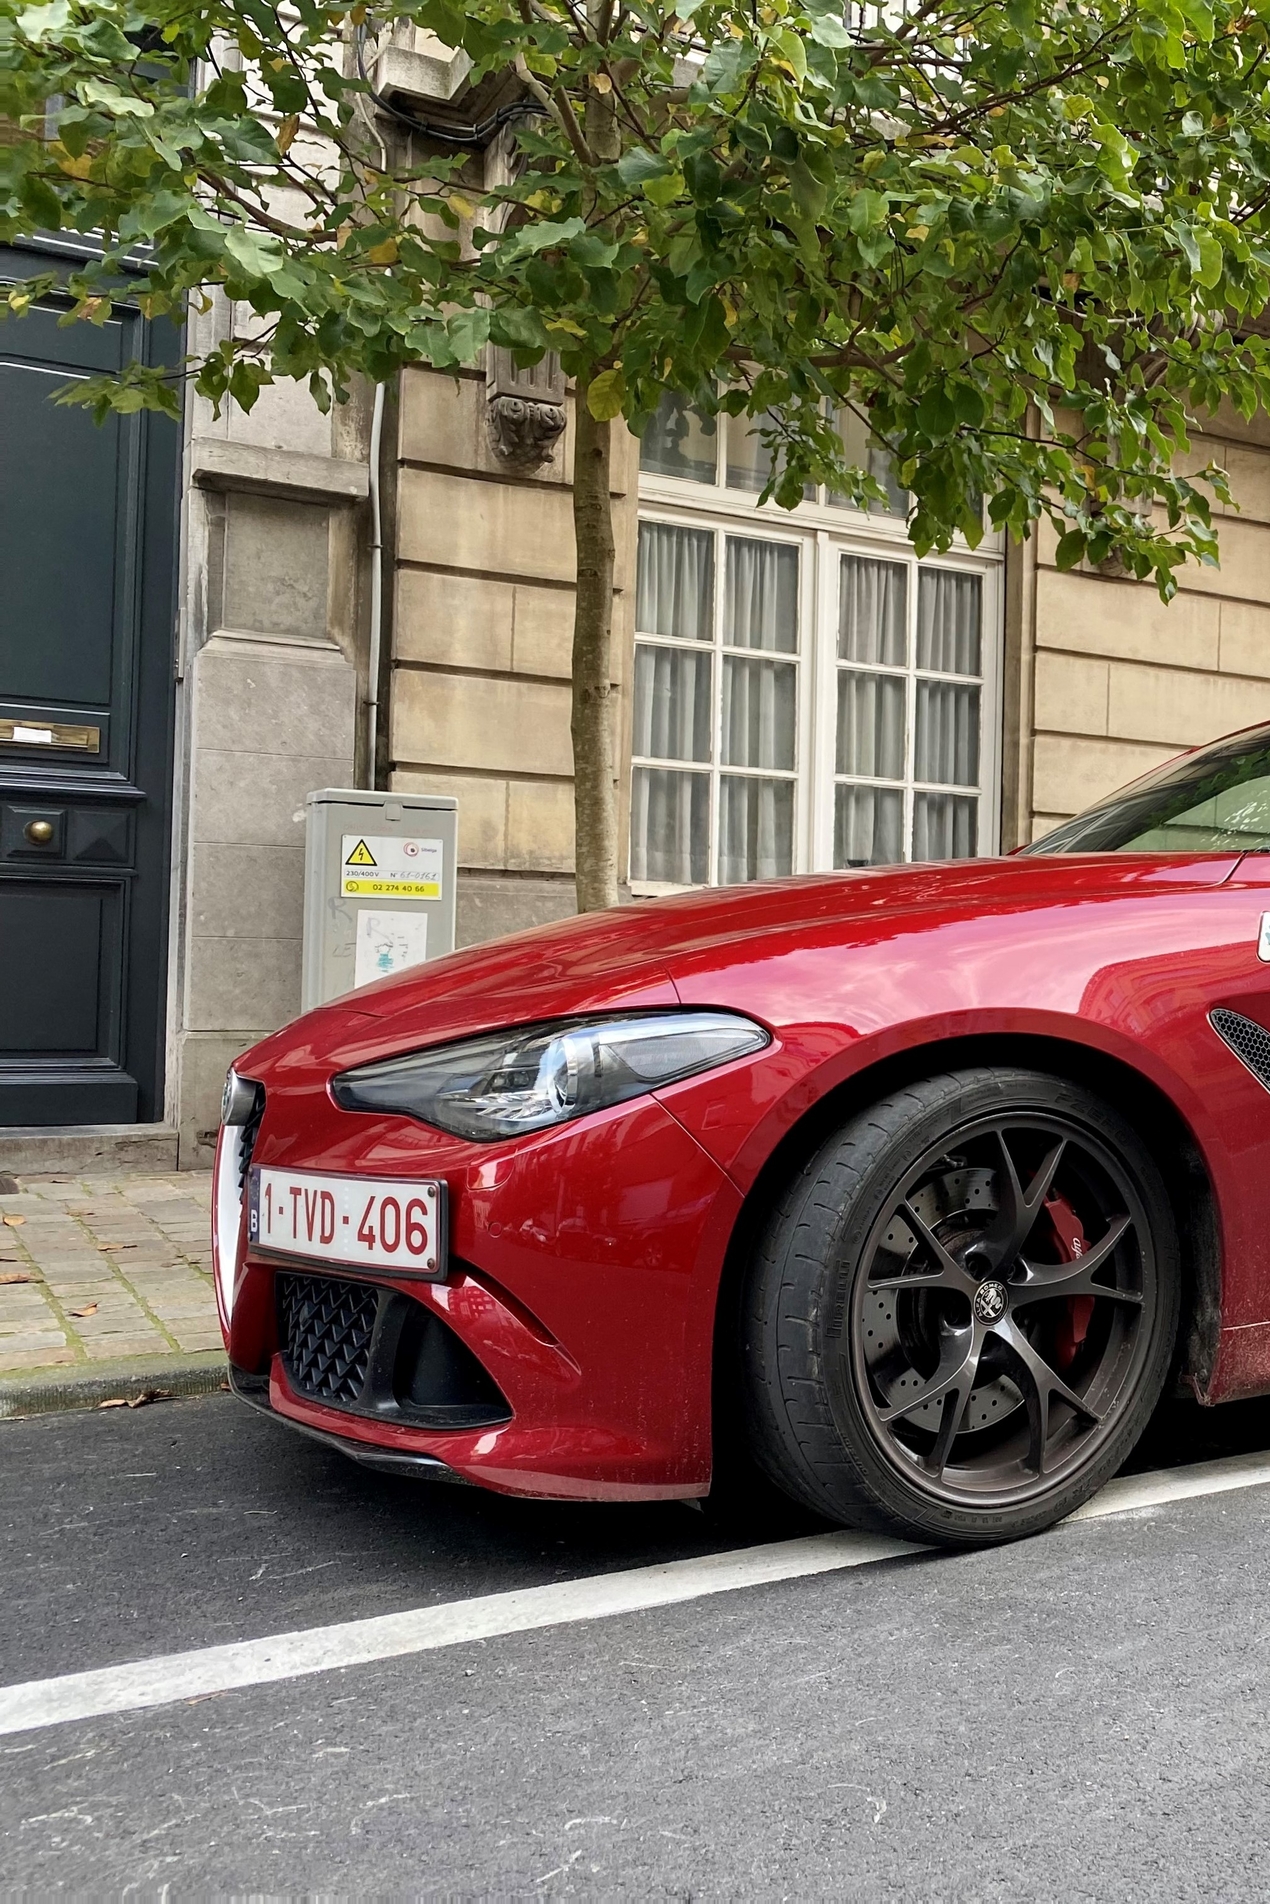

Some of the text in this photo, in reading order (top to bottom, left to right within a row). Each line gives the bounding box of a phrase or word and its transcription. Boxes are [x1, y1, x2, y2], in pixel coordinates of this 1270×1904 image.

[372, 883, 383, 891] 02
[385, 884, 400, 892] 274
[415, 885, 425, 893] 66
[250, 1209, 258, 1233] B
[979, 1283, 1003, 1295] ROMEO
